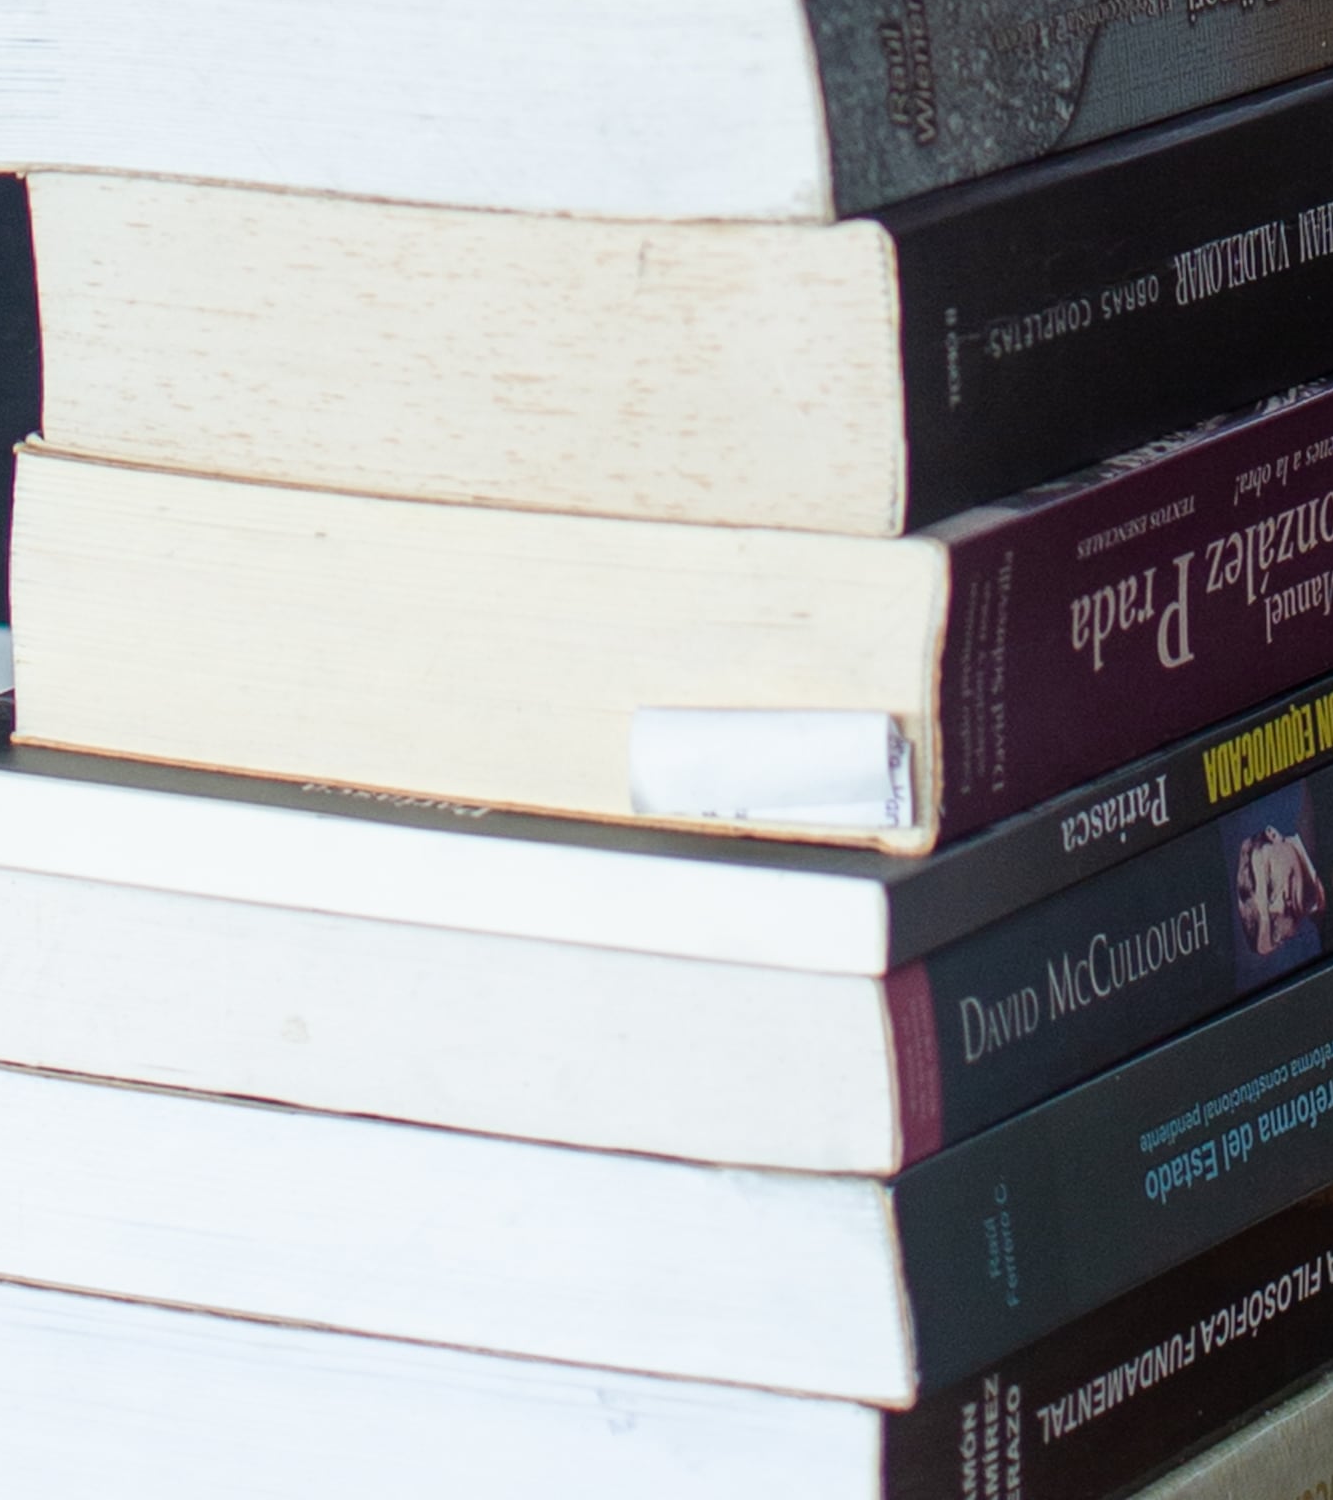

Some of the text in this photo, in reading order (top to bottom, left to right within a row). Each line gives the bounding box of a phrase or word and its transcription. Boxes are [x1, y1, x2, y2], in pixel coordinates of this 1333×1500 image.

[1173, 219, 1289, 306] VALDELOMAR
[988, 275, 1159, 359] OBRAS COMPLETAS
[1234, 464, 1271, 505] obra!
[1277, 457, 1289, 485] la
[1294, 450, 1301, 470] a
[1077, 495, 1195, 559] TEXTOS ESENCIALES
[1070, 551, 1194, 672] Prada
[990, 702, 1005, 792] David
[1203, 703, 1315, 804] EQUIVOCADA
[1061, 774, 1169, 853] Pariasca
[1139, 1102, 1201, 1155] pendiente
[1203, 1066, 1289, 1127] constitucional
[1144, 1139, 1218, 1205] Estado
[1223, 1123, 1254, 1171] del
[1201, 1256, 1322, 1353] FILOSÓFICA
[1037, 1326, 1196, 1444] FUNDAMENTAL
